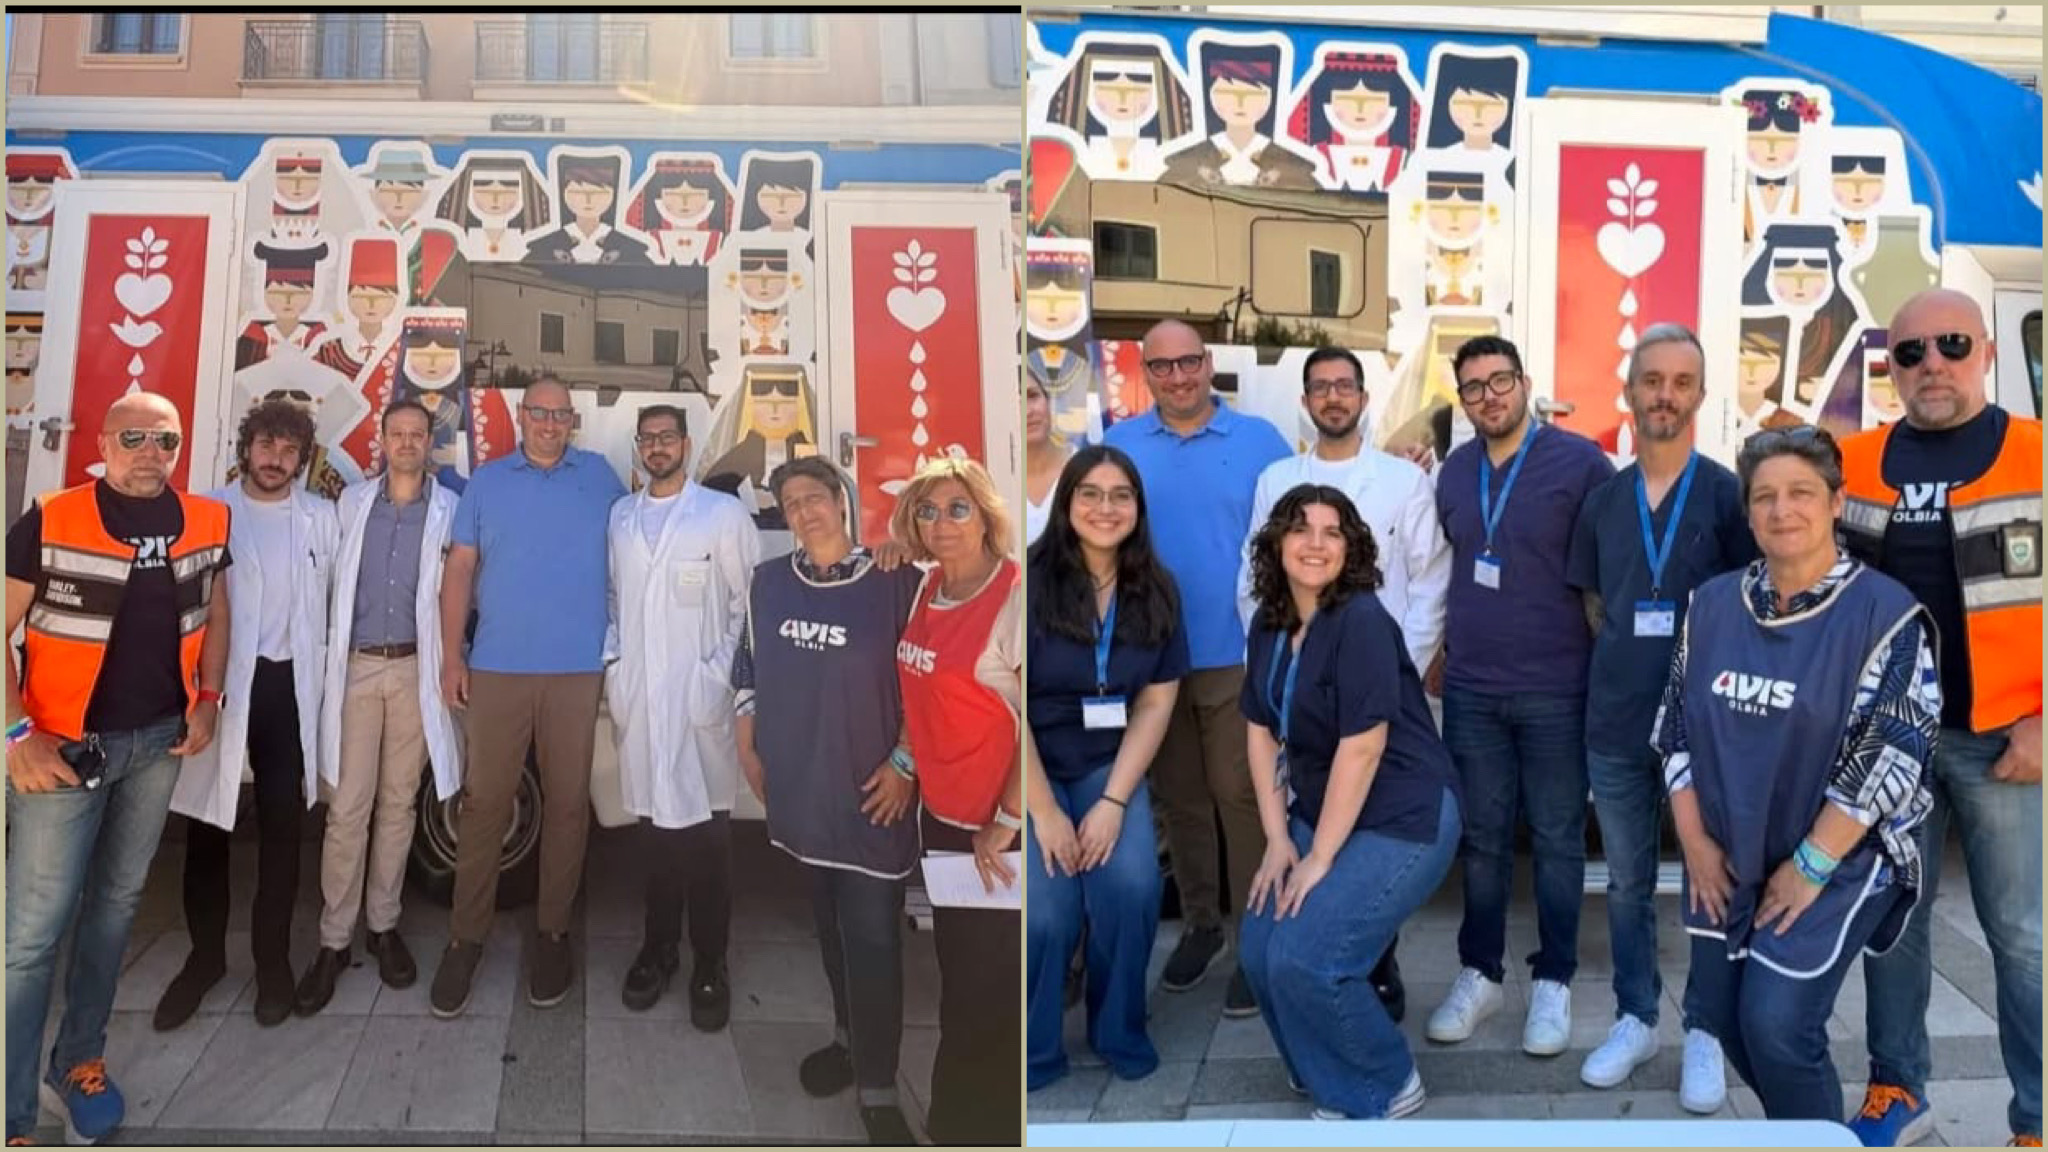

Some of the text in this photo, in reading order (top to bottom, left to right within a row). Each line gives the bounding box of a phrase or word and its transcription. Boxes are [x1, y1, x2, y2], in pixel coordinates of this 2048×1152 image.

[1895, 480, 1966, 510] VI
[1893, 510, 1942, 523] OLBIA
[779, 619, 847, 646] AVIS
[1711, 670, 1797, 709] AVIS
[1728, 700, 1767, 716] OLBIA
